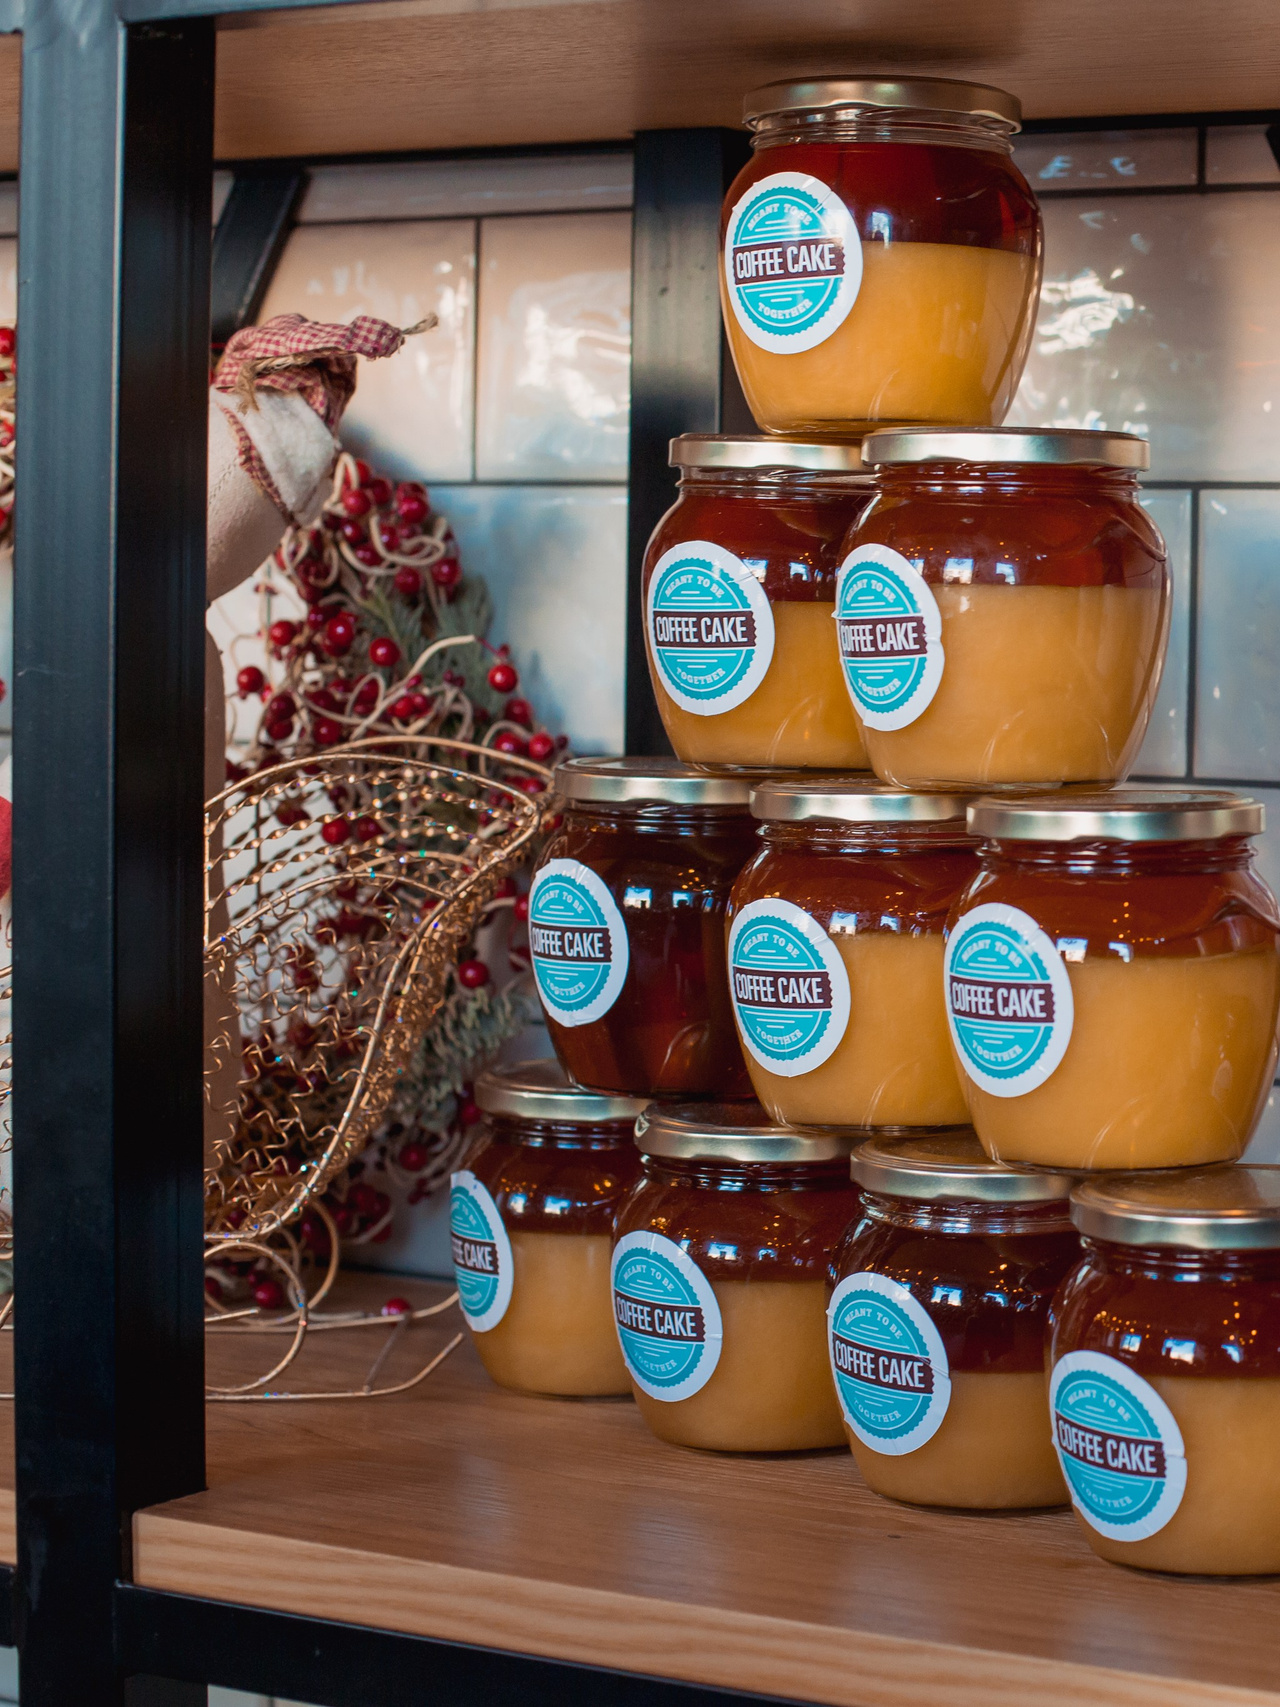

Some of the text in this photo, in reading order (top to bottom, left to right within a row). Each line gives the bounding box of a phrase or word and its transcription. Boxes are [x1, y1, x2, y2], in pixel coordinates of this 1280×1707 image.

[736, 244, 836, 279] COFFEE CAKE
[758, 299, 813, 319] TOGETHER
[697, 576, 710, 588] TO
[710, 583, 725, 598] BE
[656, 616, 748, 643] COFFEE CAKE
[840, 622, 920, 652] COFFEE CAKE
[676, 668, 726, 685] TOGETHER
[531, 927, 604, 958] COFFEE CAKE
[773, 935, 786, 946] TO
[786, 944, 800, 958] BE
[994, 941, 1008, 954] TO
[735, 973, 824, 1004] COFFEE CAKE
[952, 982, 1047, 1018] COFFEE CAKE
[756, 1026, 803, 1044] TOGETHER
[464, 1242, 494, 1271] CAKE
[651, 1268, 661, 1280] TO
[662, 1278, 675, 1292] BE
[617, 1296, 697, 1337] COFFEE CAKE
[844, 1309, 903, 1339] MEANT TO BE
[835, 1340, 925, 1388] COFFEE CAKE
[1103, 1394, 1116, 1408] TO
[1059, 1419, 1157, 1473] COFFEE CAKE
